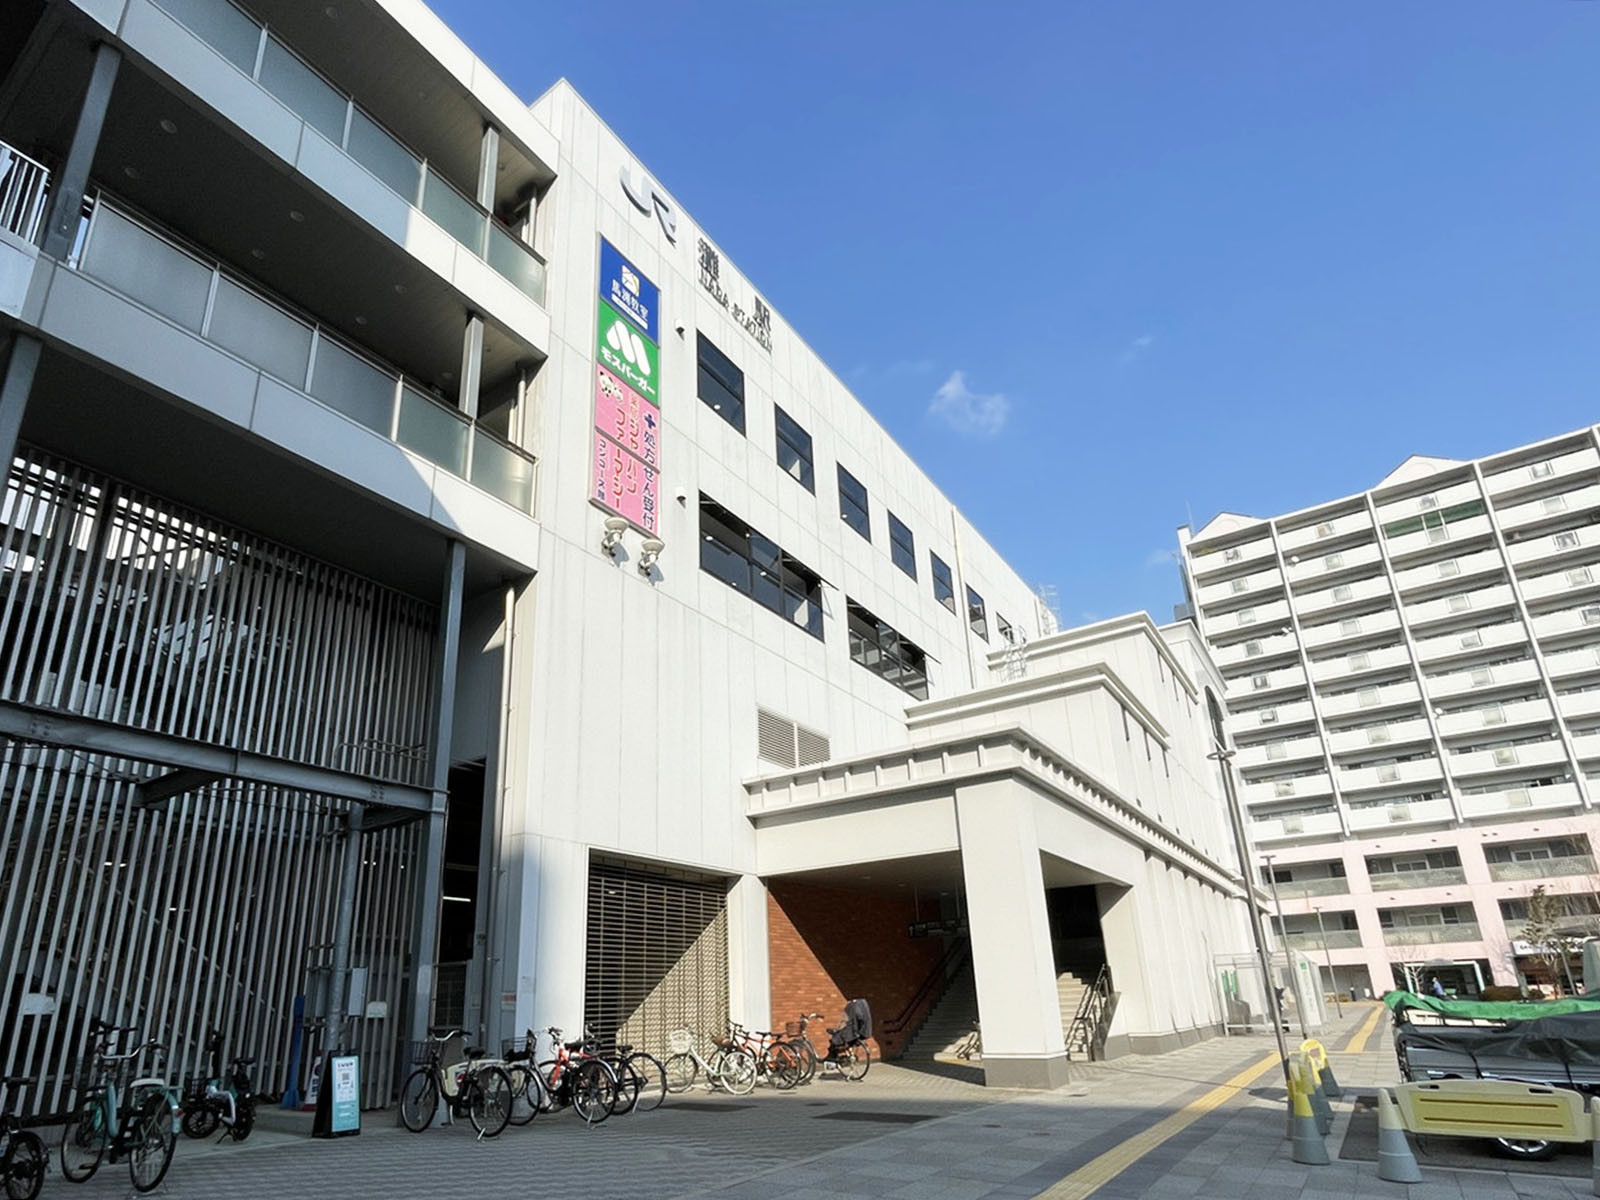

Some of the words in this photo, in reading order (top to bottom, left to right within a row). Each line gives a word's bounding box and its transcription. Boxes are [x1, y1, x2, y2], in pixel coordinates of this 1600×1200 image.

[619, 165, 676, 249] JR
[600, 345, 656, 395] モスバーガー
[613, 407, 626, 508] ファーマシー
[627, 418, 640, 494] ジャパン
[643, 430, 656, 531] 処方せん受付
